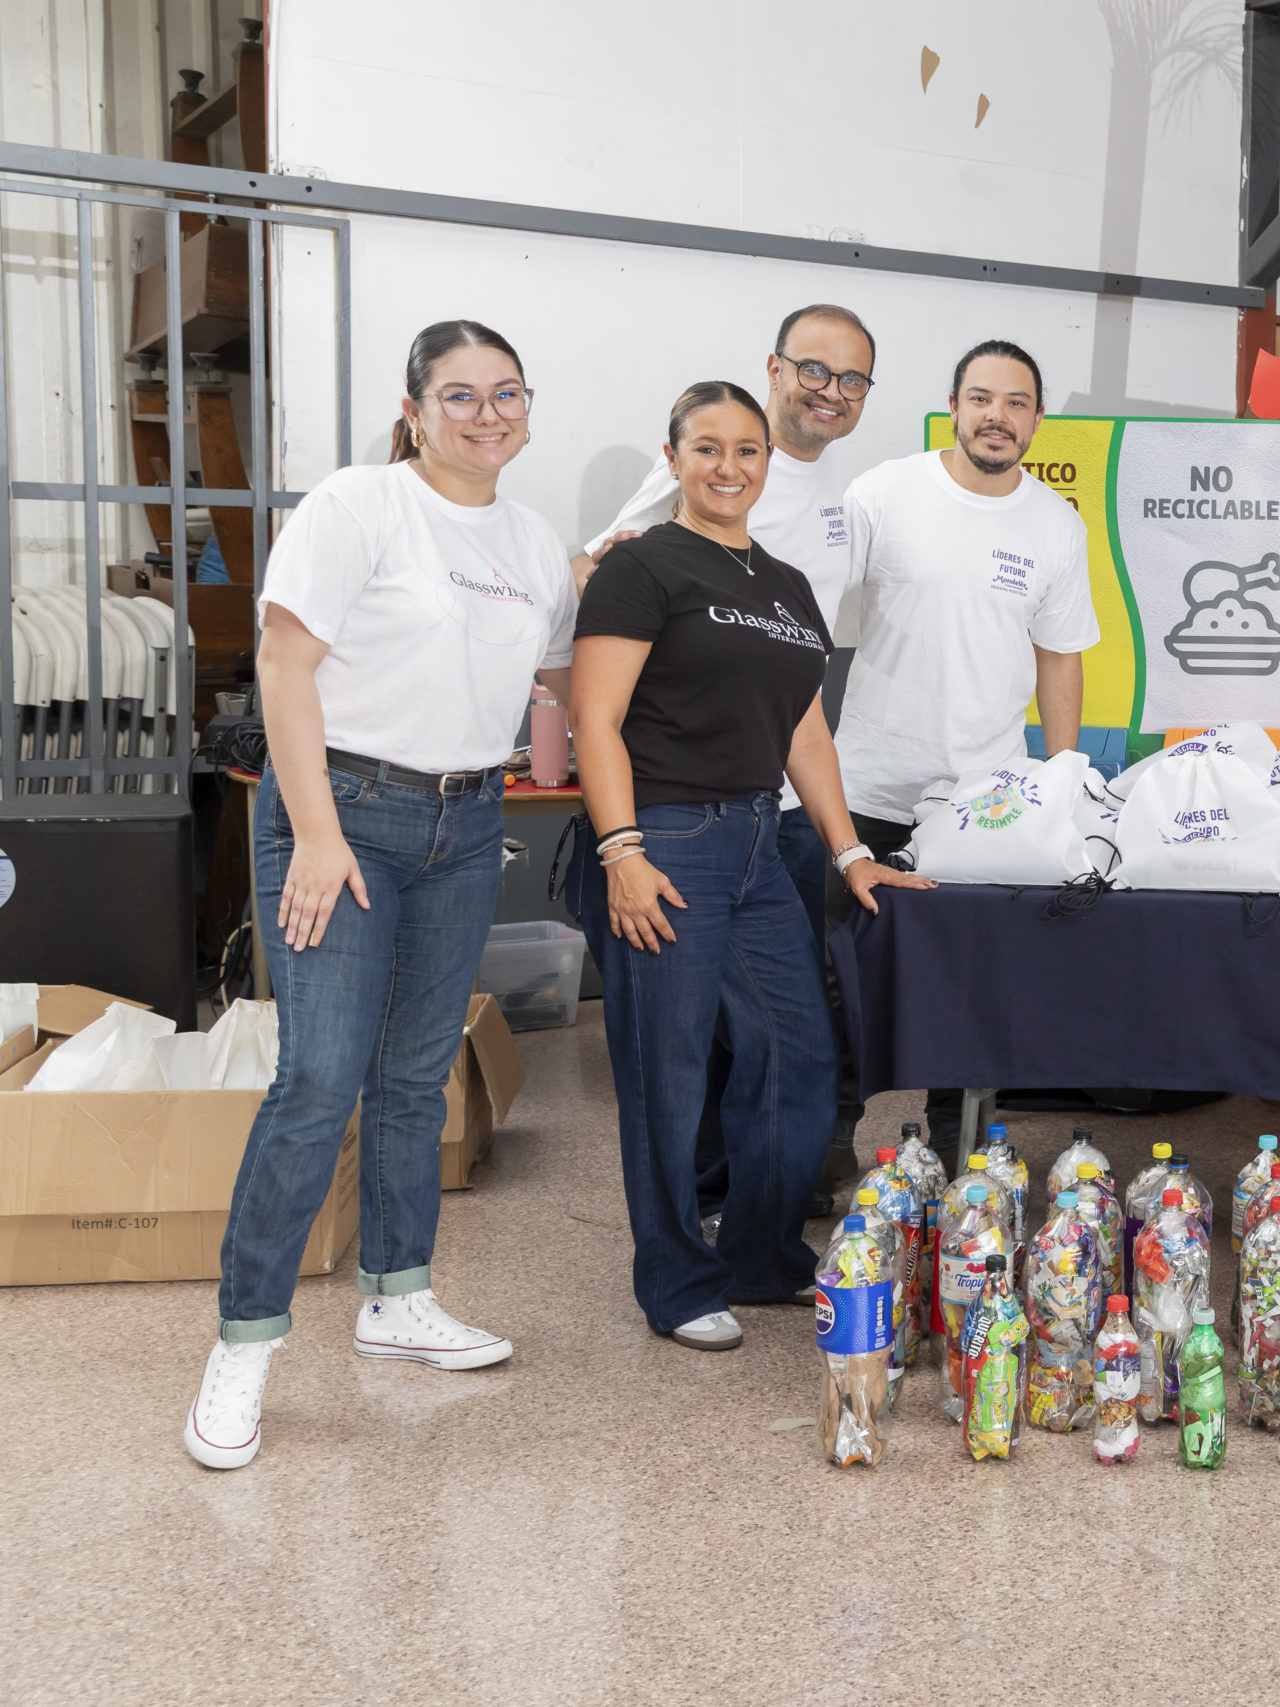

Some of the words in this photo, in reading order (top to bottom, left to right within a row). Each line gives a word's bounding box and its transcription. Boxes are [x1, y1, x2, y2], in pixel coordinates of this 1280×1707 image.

[1022, 462, 1077, 483] TICO
[1190, 465, 1234, 493] NO
[1143, 499, 1280, 521] RECICLABLE
[1000, 563, 1026, 578] FUTURO
[1023, 557, 1035, 569] DEL
[708, 605, 824, 645] Glasswin
[976, 807, 1022, 830] RESIMPLE
[1209, 808, 1231, 821] DEL
[71, 1217, 160, 1231] Item#:C-107
[816, 1306, 833, 1320] EPSI
[968, 1316, 992, 1360] QUERITO
